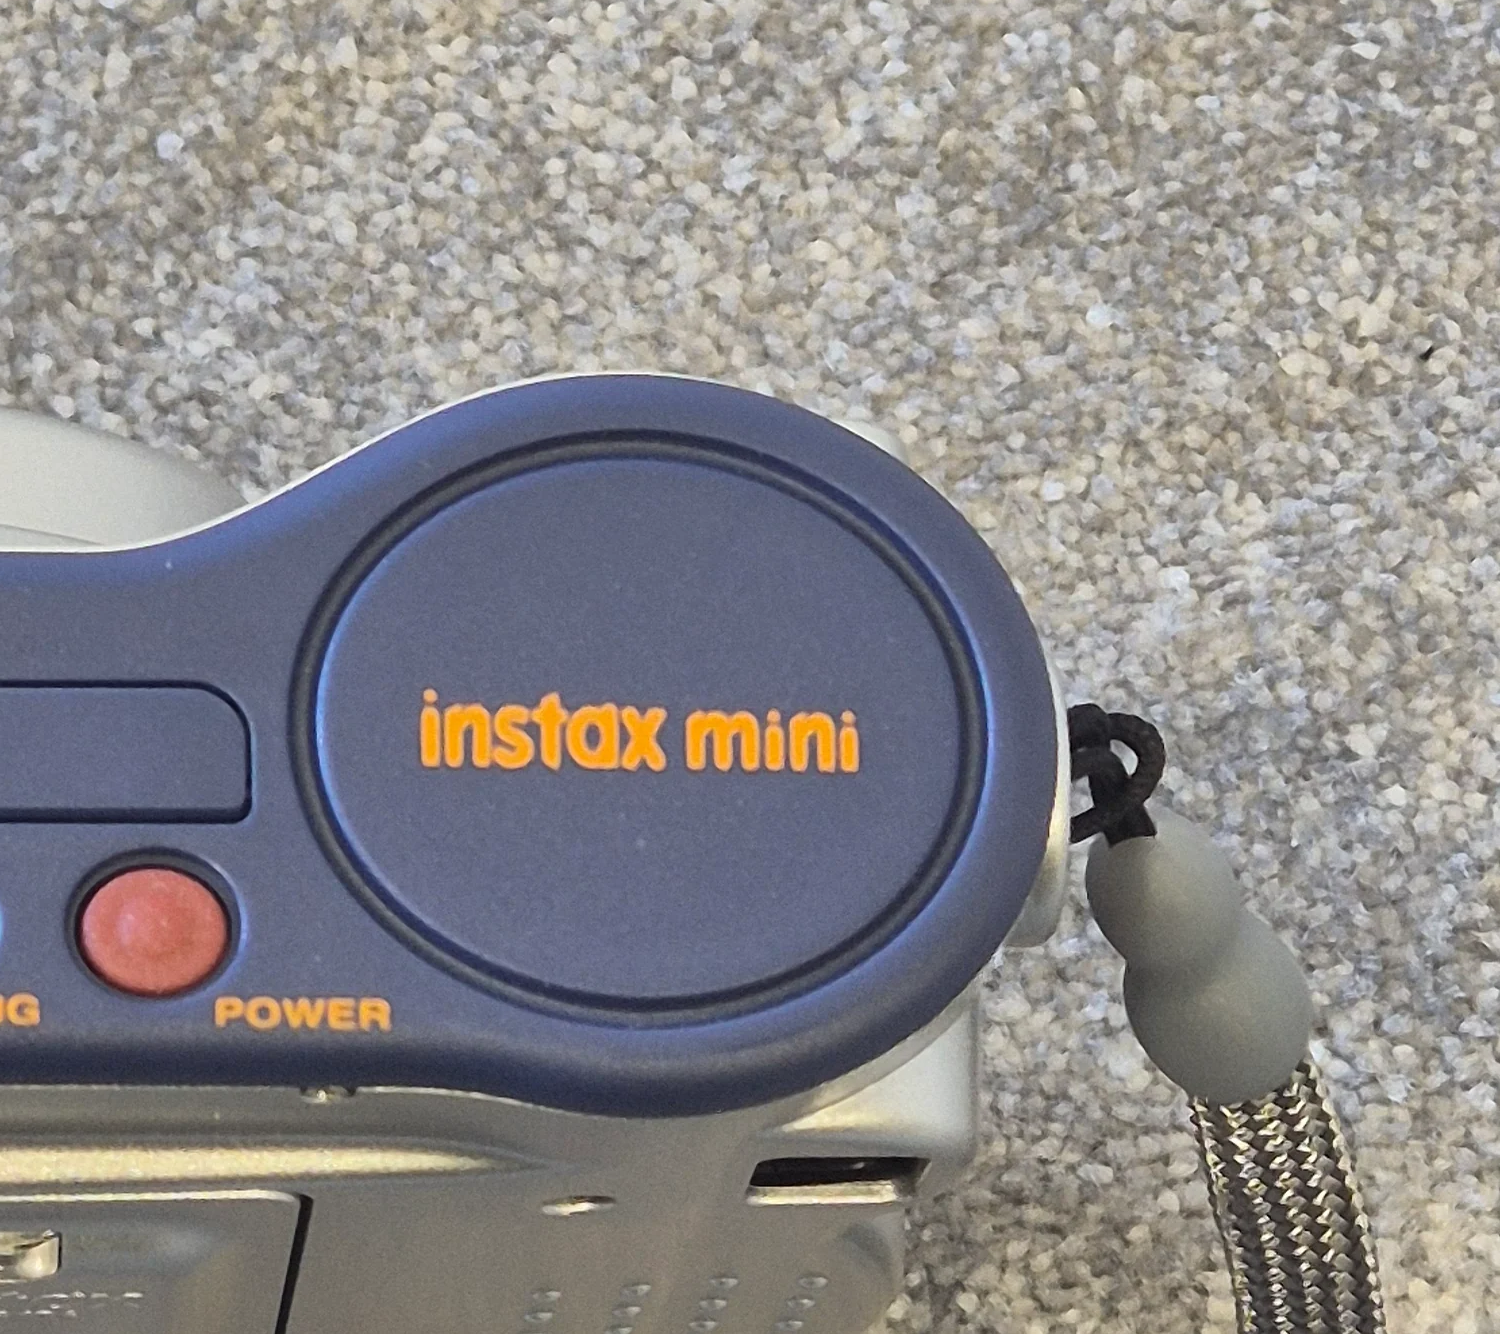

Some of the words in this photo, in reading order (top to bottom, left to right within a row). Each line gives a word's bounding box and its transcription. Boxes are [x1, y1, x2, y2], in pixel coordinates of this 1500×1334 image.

[419, 689, 667, 772] instax
[684, 710, 859, 773] mini
[214, 996, 391, 1032] POWER
